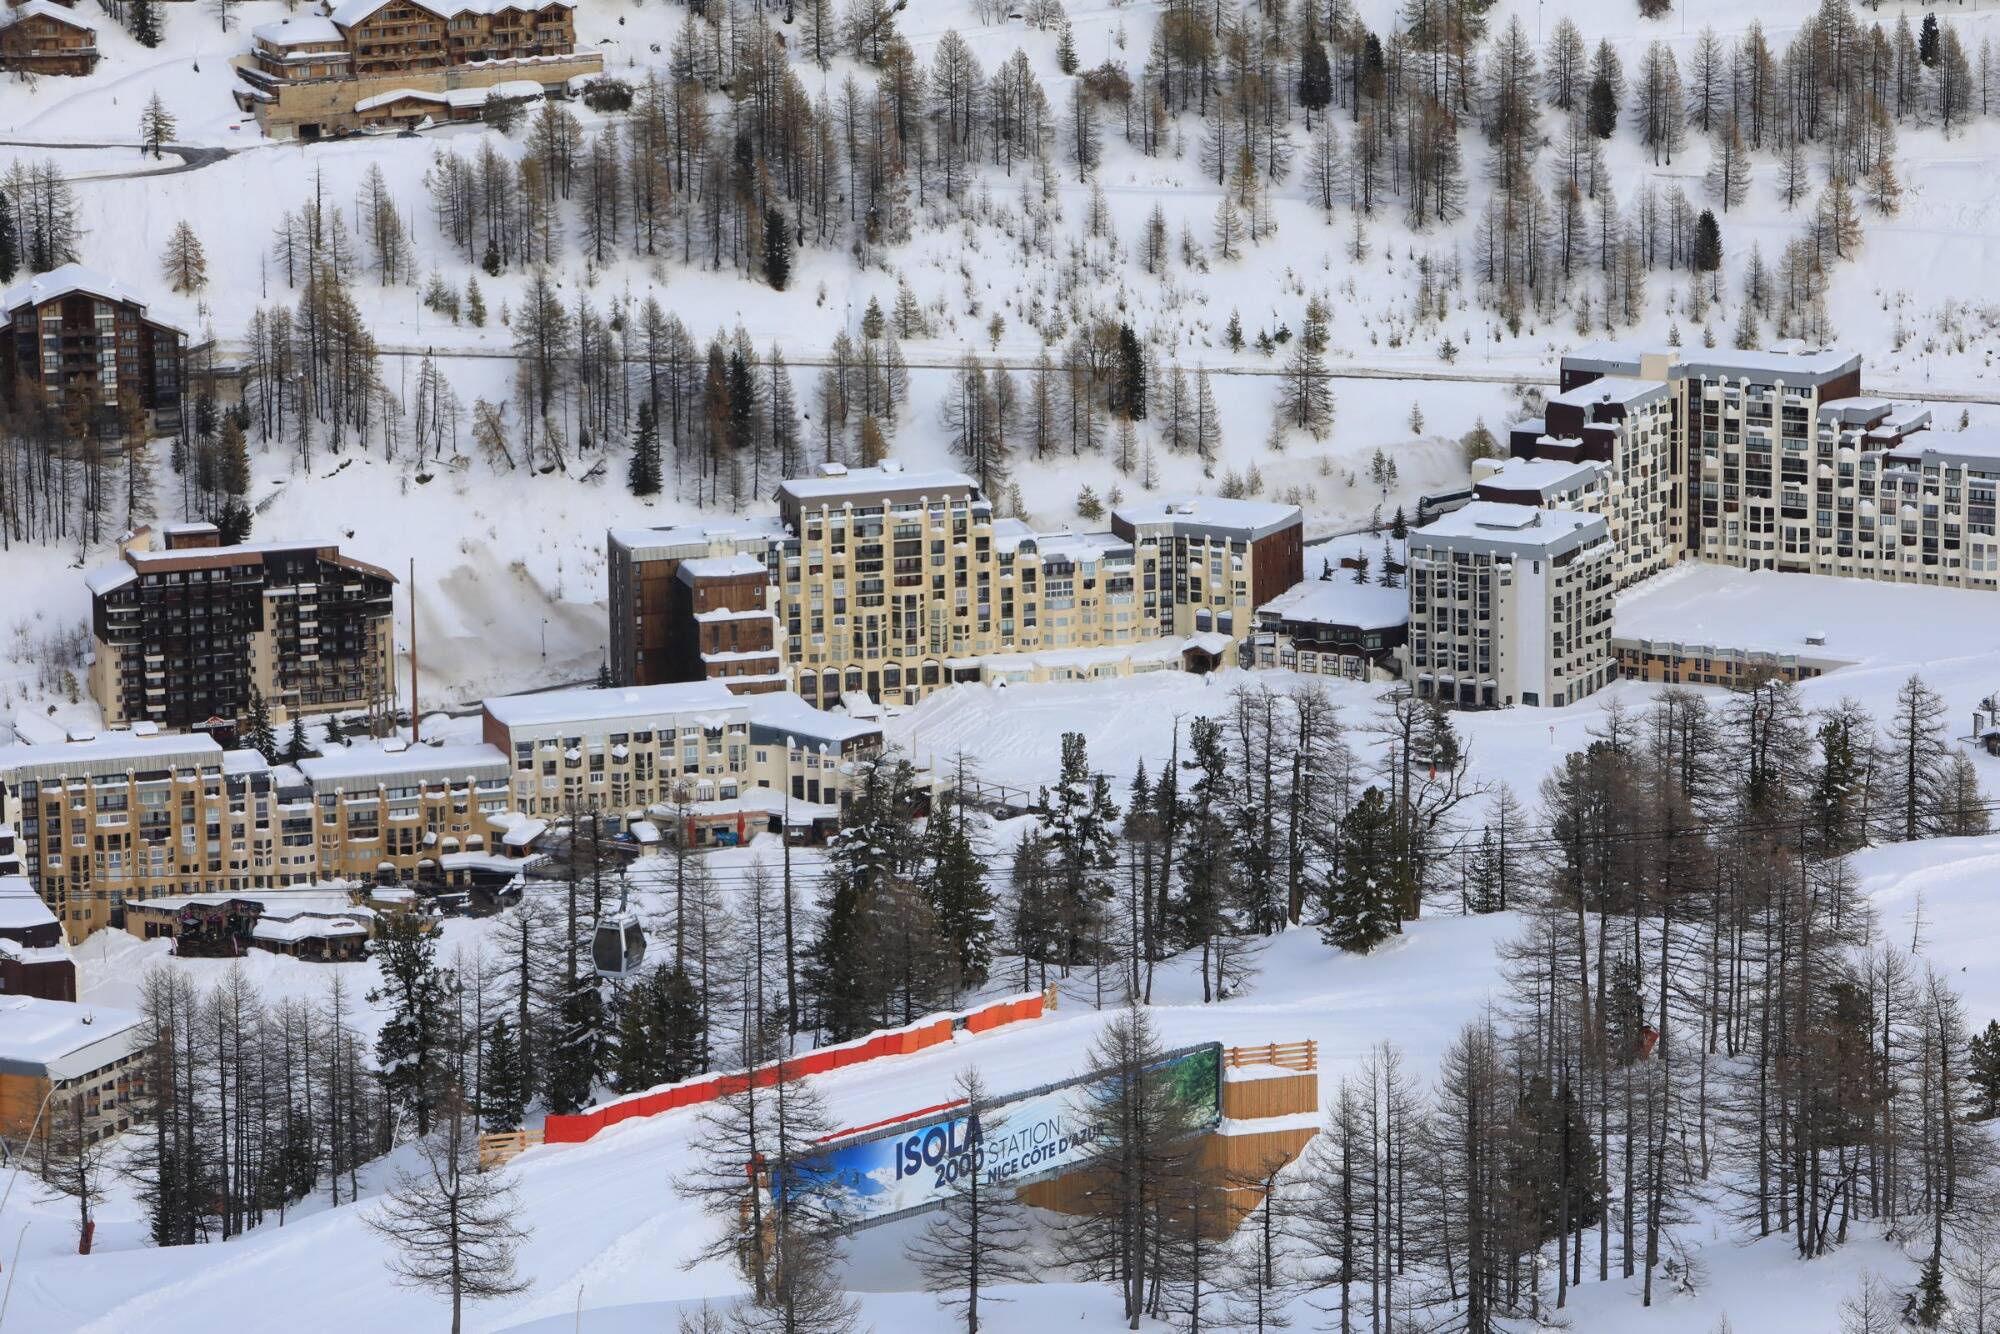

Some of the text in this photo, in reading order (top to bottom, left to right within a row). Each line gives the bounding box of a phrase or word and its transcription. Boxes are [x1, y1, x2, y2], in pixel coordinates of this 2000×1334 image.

[895, 1111, 985, 1181] ISOLA
[988, 1115, 1061, 1165] STATION
[988, 1121, 1105, 1184] NICE CÔTE D'AZUR
[934, 1148, 984, 1189] 2000
